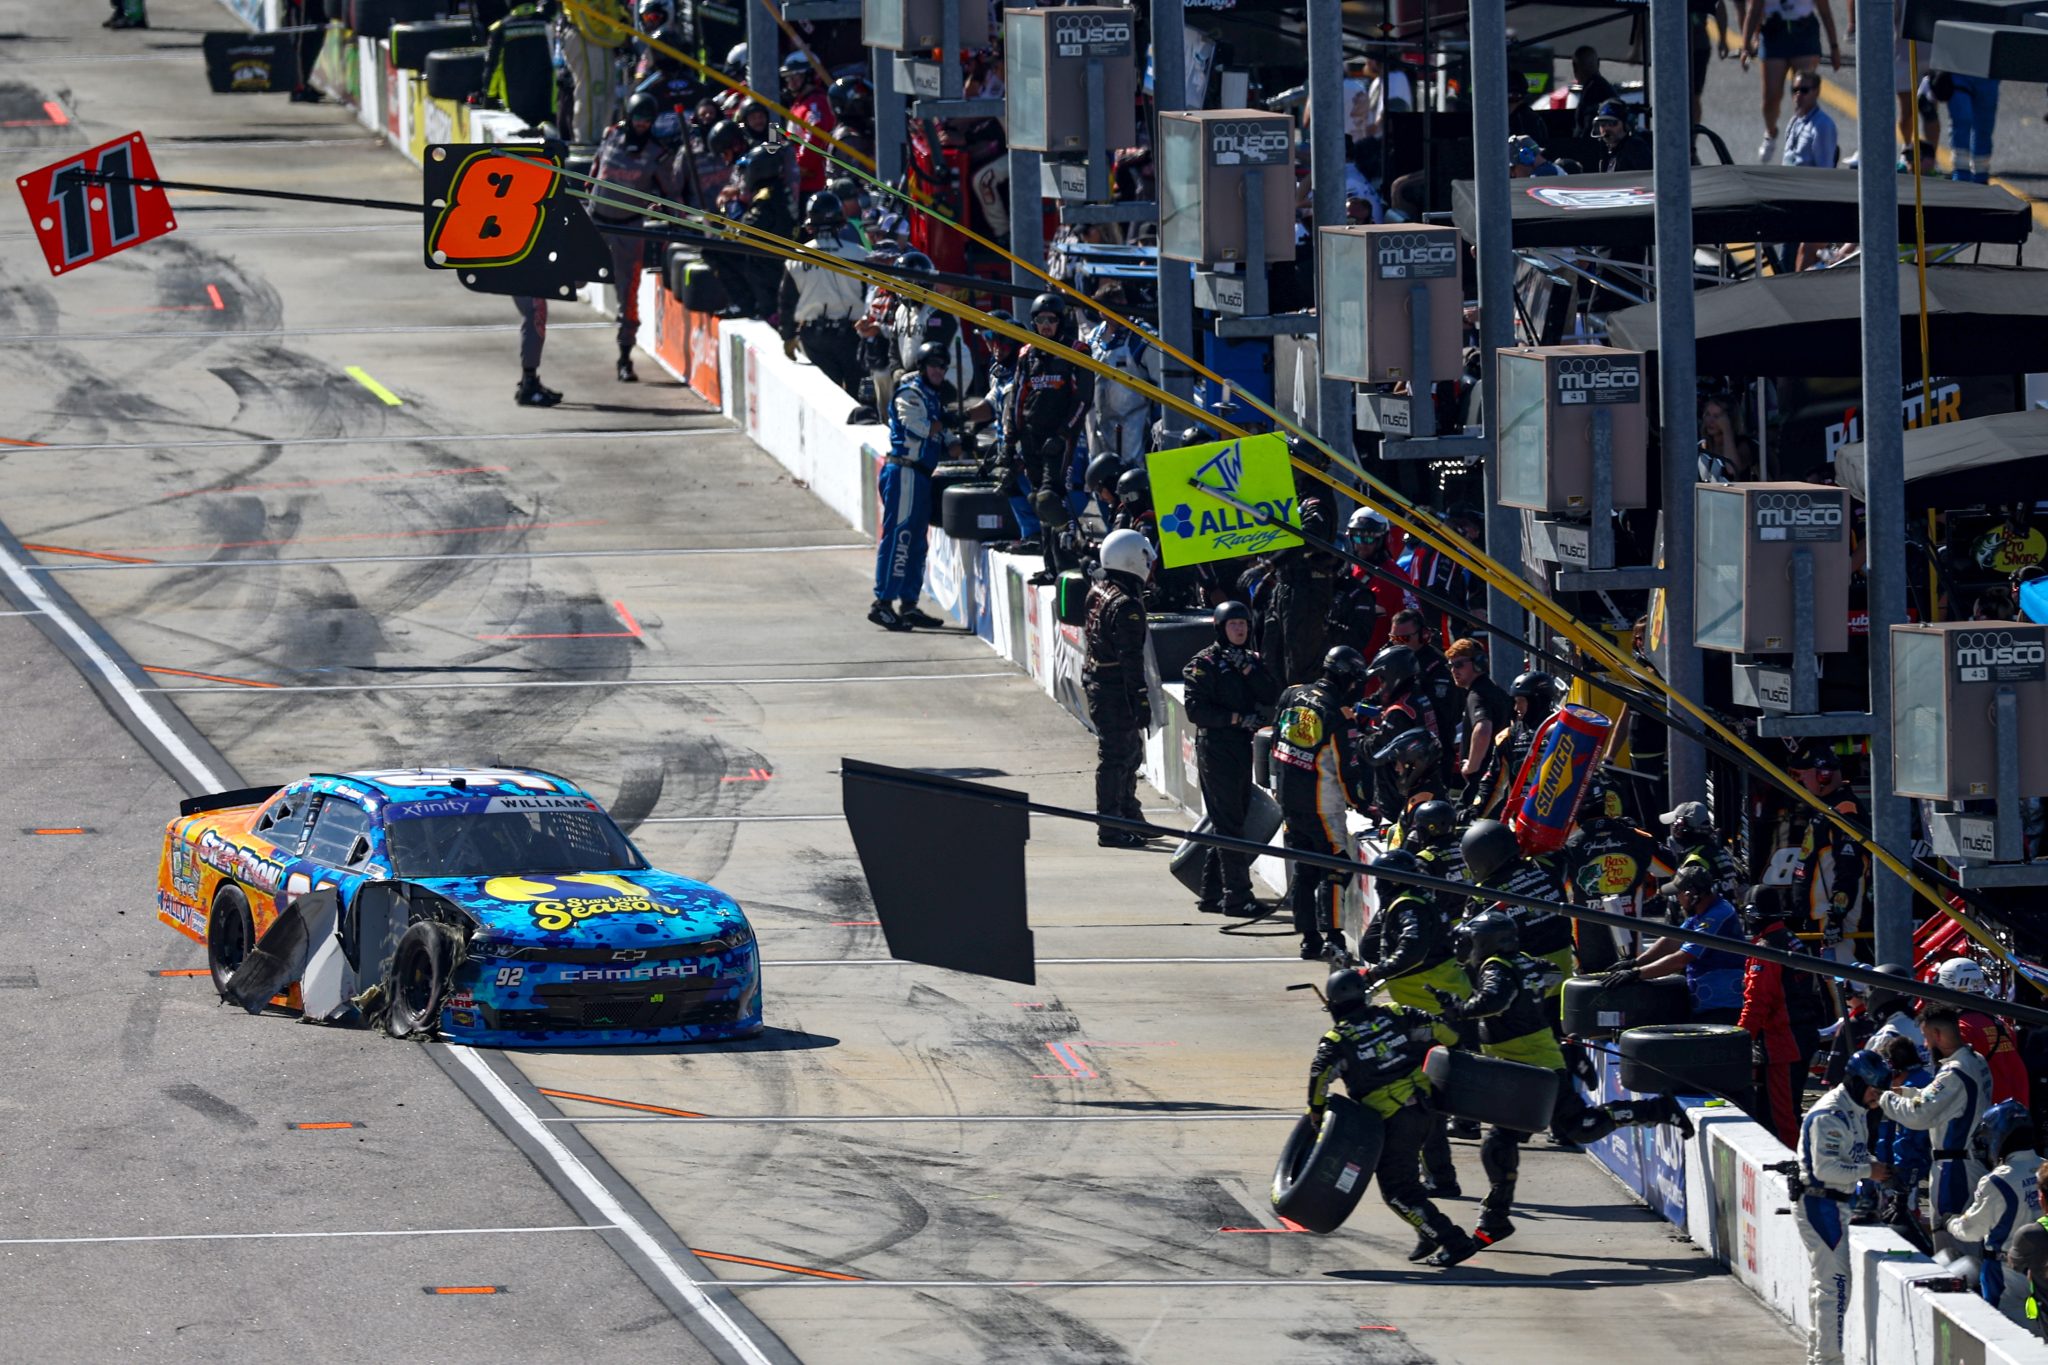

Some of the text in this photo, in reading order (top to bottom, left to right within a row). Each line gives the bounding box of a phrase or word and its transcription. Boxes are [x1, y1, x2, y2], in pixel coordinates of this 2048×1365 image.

[1056, 27, 1130, 45] MUSCO
[1213, 135, 1288, 151] MUSCO
[48, 141, 141, 264] 11
[437, 156, 553, 259] 8
[1378, 246, 1456, 265] MUSCO
[1557, 371, 1640, 390] MUSCO
[1382, 411, 1408, 428] MUSCO
[1199, 498, 1294, 536] ALLOY
[1757, 509, 1842, 526] MUSCO
[1213, 529, 1289, 552] Racing
[1559, 543, 1587, 559] MUSCO
[1957, 646, 2045, 666] MUSCO
[1761, 688, 1789, 704] MUSCO
[1536, 734, 1575, 817] SUNOCO
[402, 801, 470, 816] xfinity
[1962, 837, 1993, 852] MUSCO
[535, 901, 680, 931] Season
[495, 967, 525, 986] 92
[560, 964, 698, 981] CAMARO
